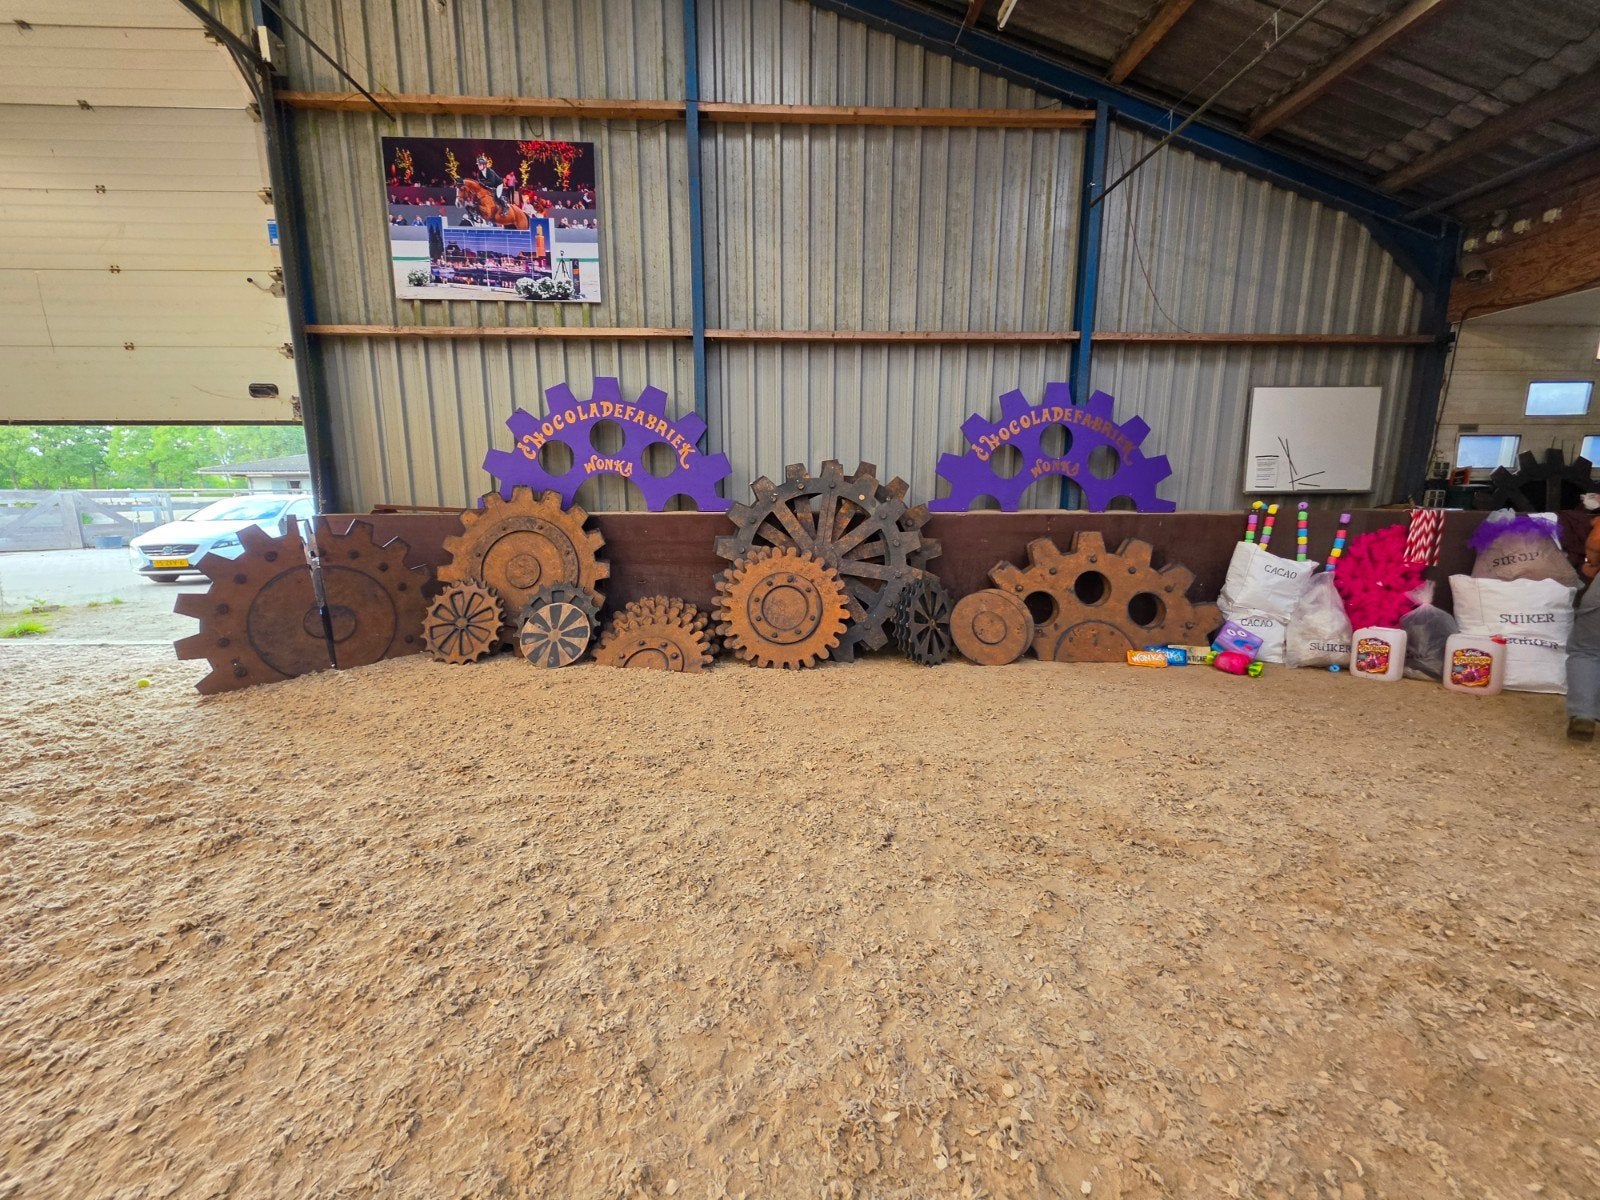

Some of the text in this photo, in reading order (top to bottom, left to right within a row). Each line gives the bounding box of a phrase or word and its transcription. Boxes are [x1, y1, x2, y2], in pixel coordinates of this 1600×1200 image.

[583, 454, 633, 477] WONKA
[1030, 458, 1080, 478] WONKA
[1492, 551, 1539, 568] SIROP
[1264, 564, 1298, 579] CACAO
[1240, 618, 1274, 628] CACAO
[1131, 653, 1165, 662] WONKA
